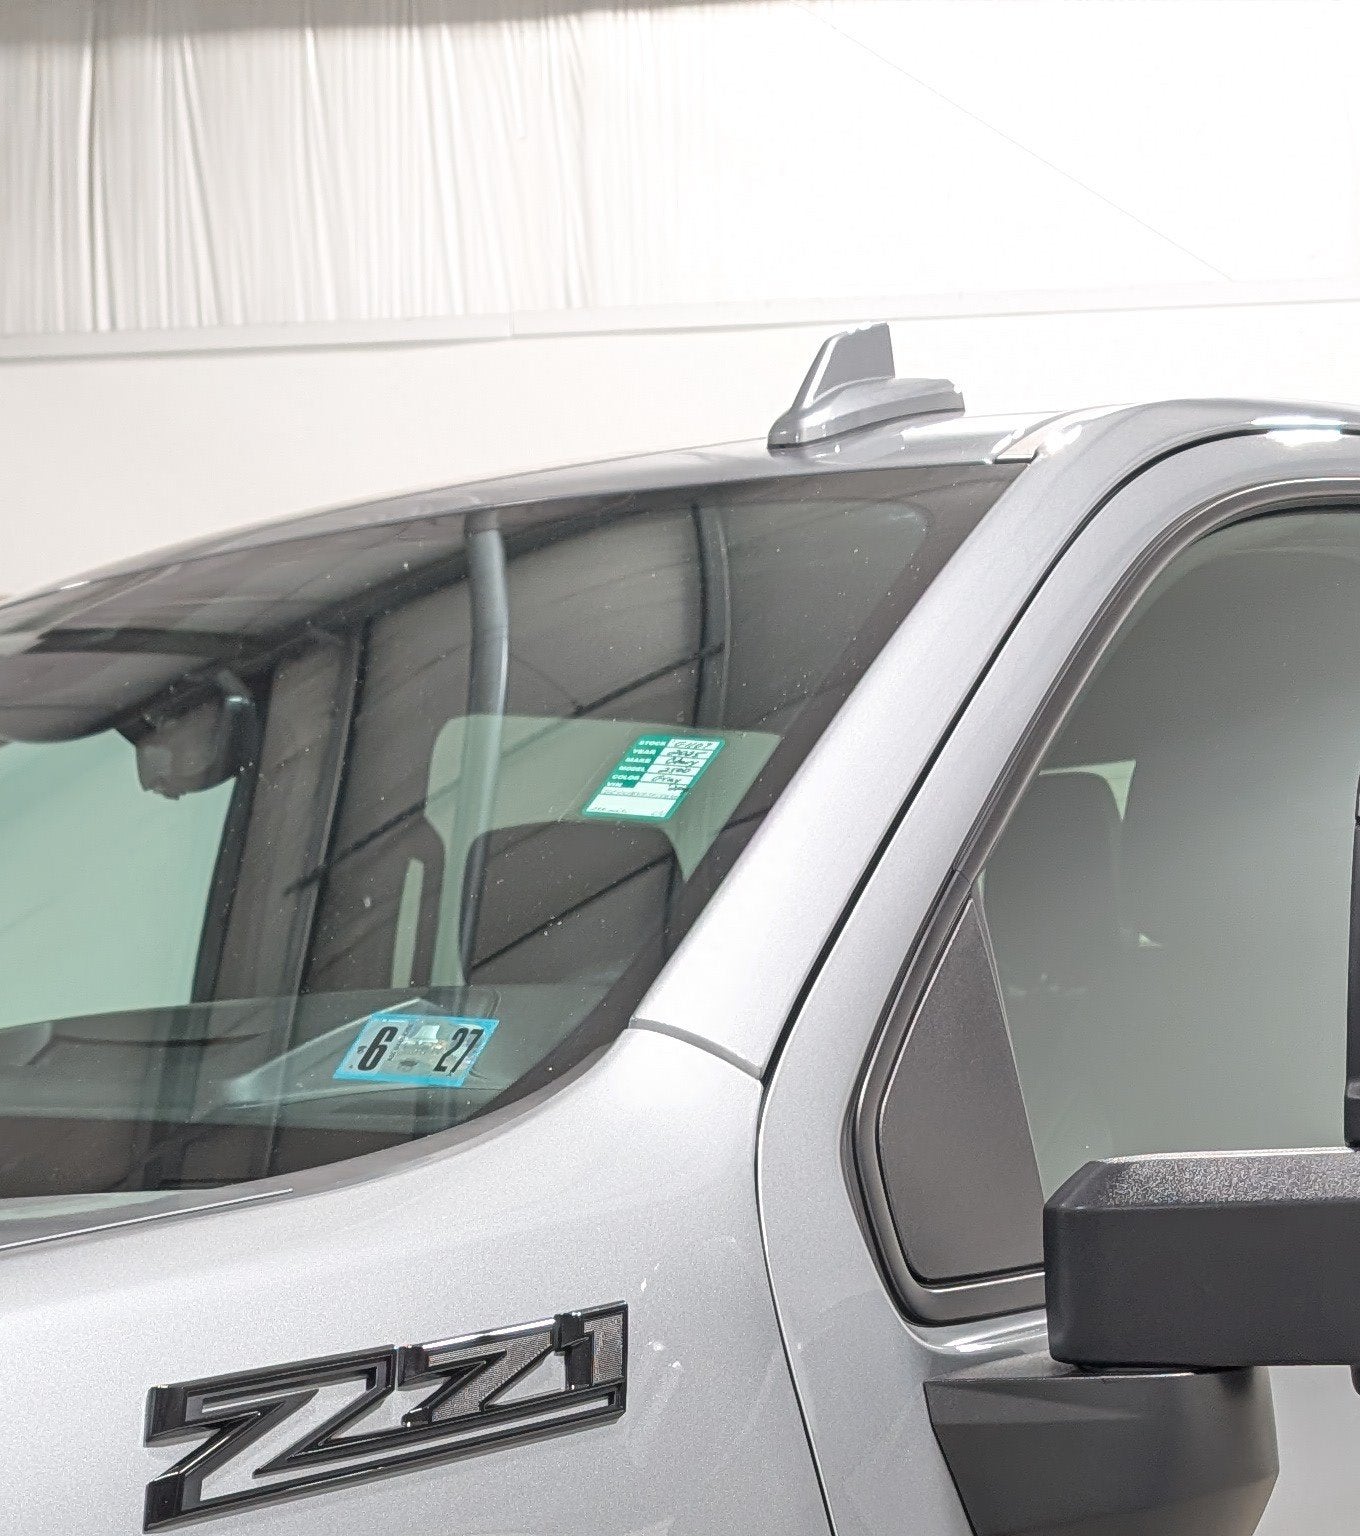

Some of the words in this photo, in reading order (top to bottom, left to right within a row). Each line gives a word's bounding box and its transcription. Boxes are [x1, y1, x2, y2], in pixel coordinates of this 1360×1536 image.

[357, 1026, 399, 1071] 6
[432, 1027, 485, 1073] 27
[144, 1300, 628, 1534] Z71
